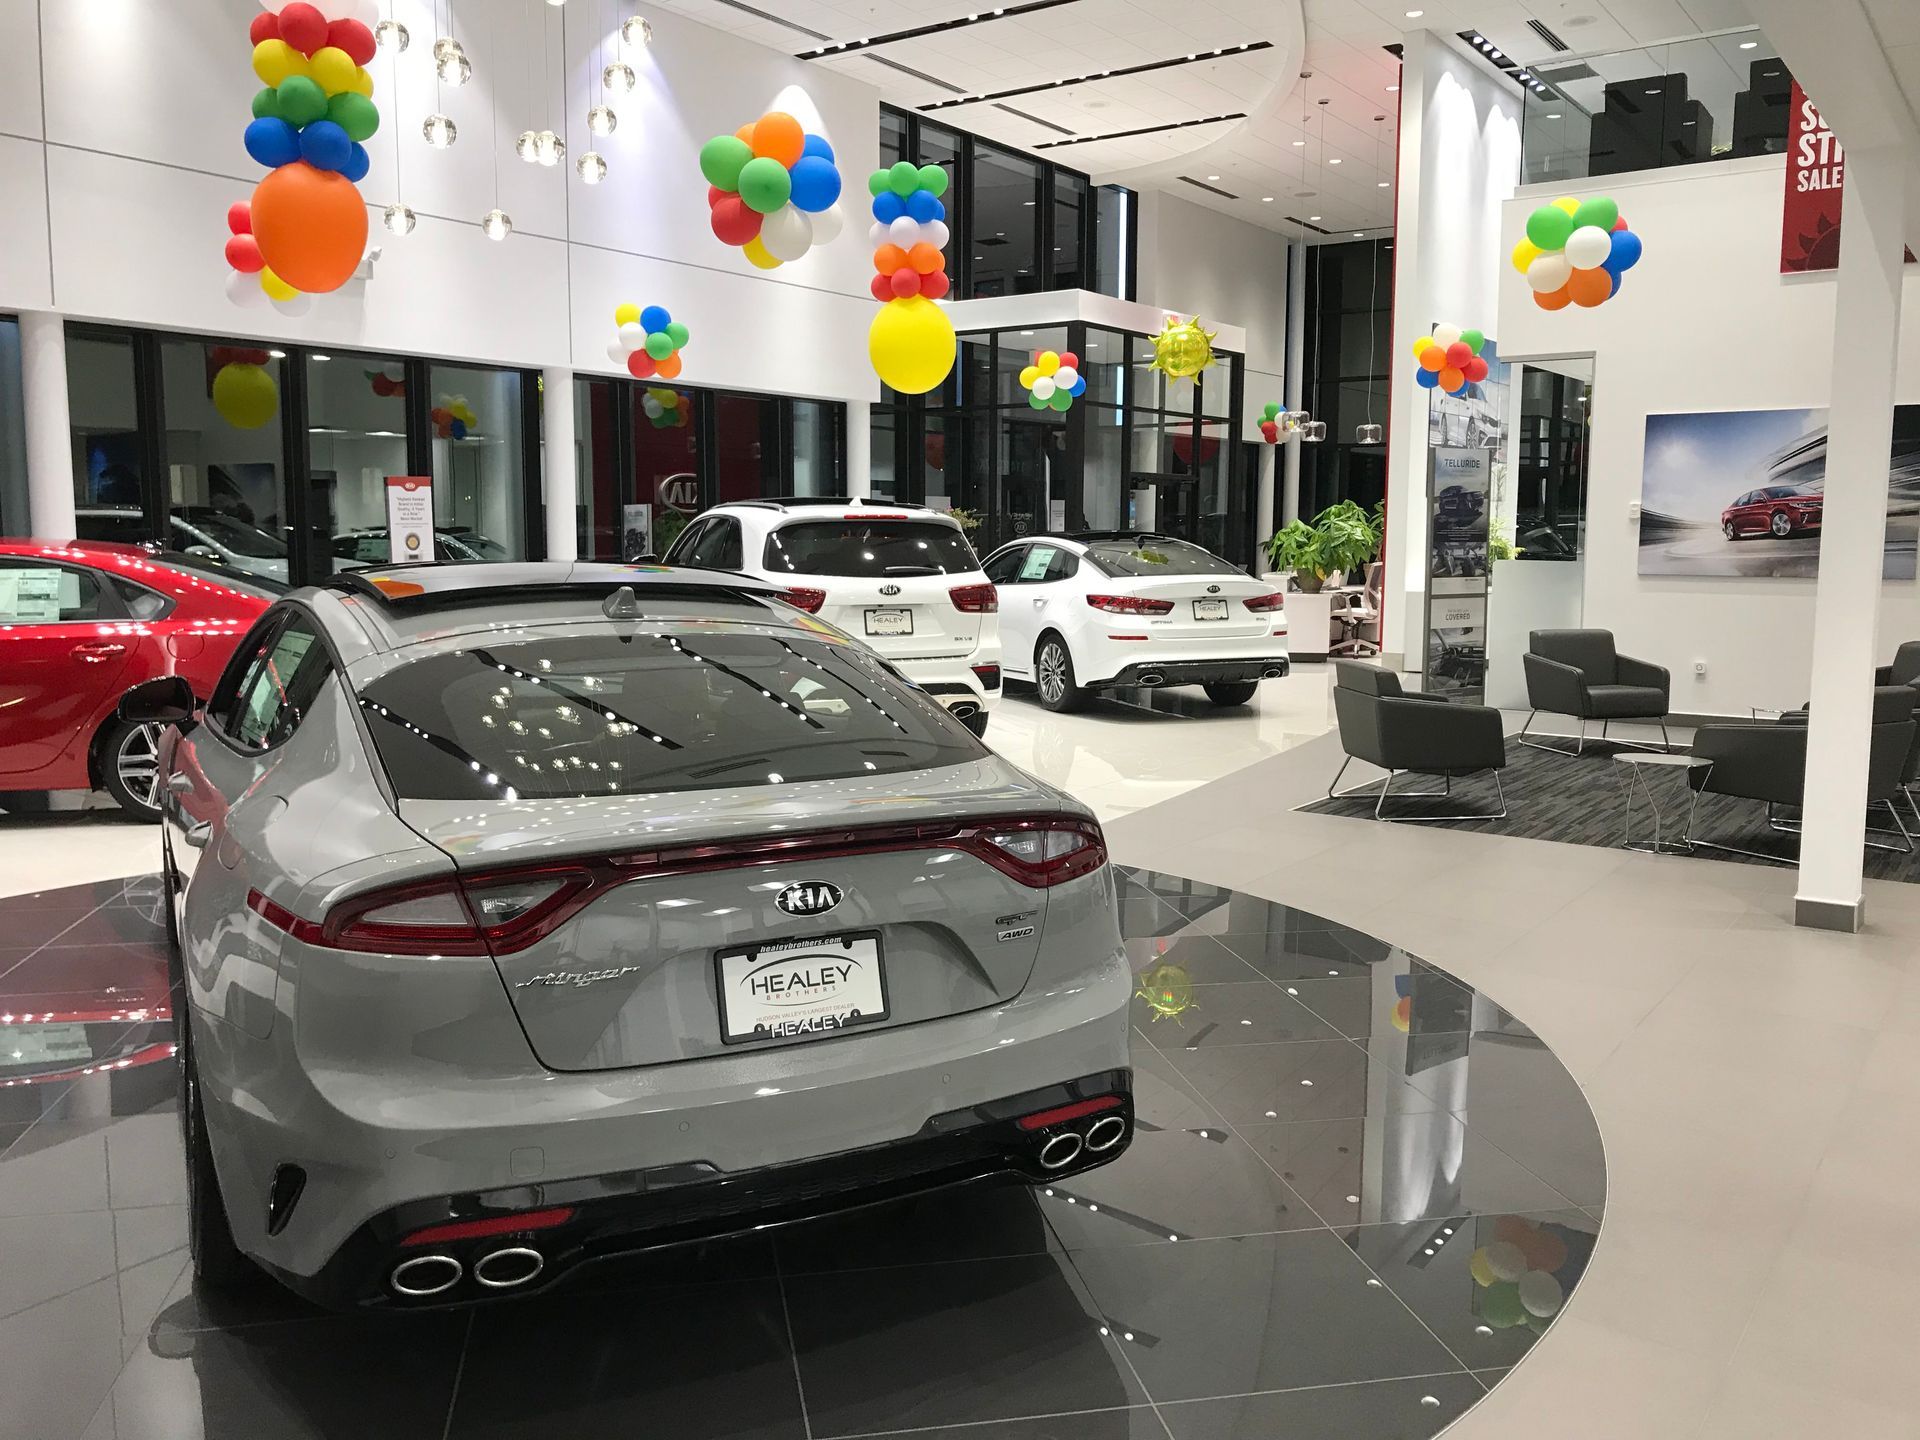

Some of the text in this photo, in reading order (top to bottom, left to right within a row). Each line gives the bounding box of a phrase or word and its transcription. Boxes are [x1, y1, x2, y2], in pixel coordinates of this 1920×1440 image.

[1797, 166, 1843, 192] SALE
[1444, 458, 1480, 469] TELLURIDE
[1445, 613, 1471, 621] COVERED
[785, 886, 835, 911] KIA
[1000, 928, 1034, 940] AWD
[760, 936, 842, 953] healeybrothers.com
[751, 964, 852, 996] HEALEY
[766, 985, 837, 1001] BROTHERS
[756, 1003, 856, 1023] HUDSON VALLEY'S LARGEST DEALER
[770, 1012, 847, 1038] HEALEY
